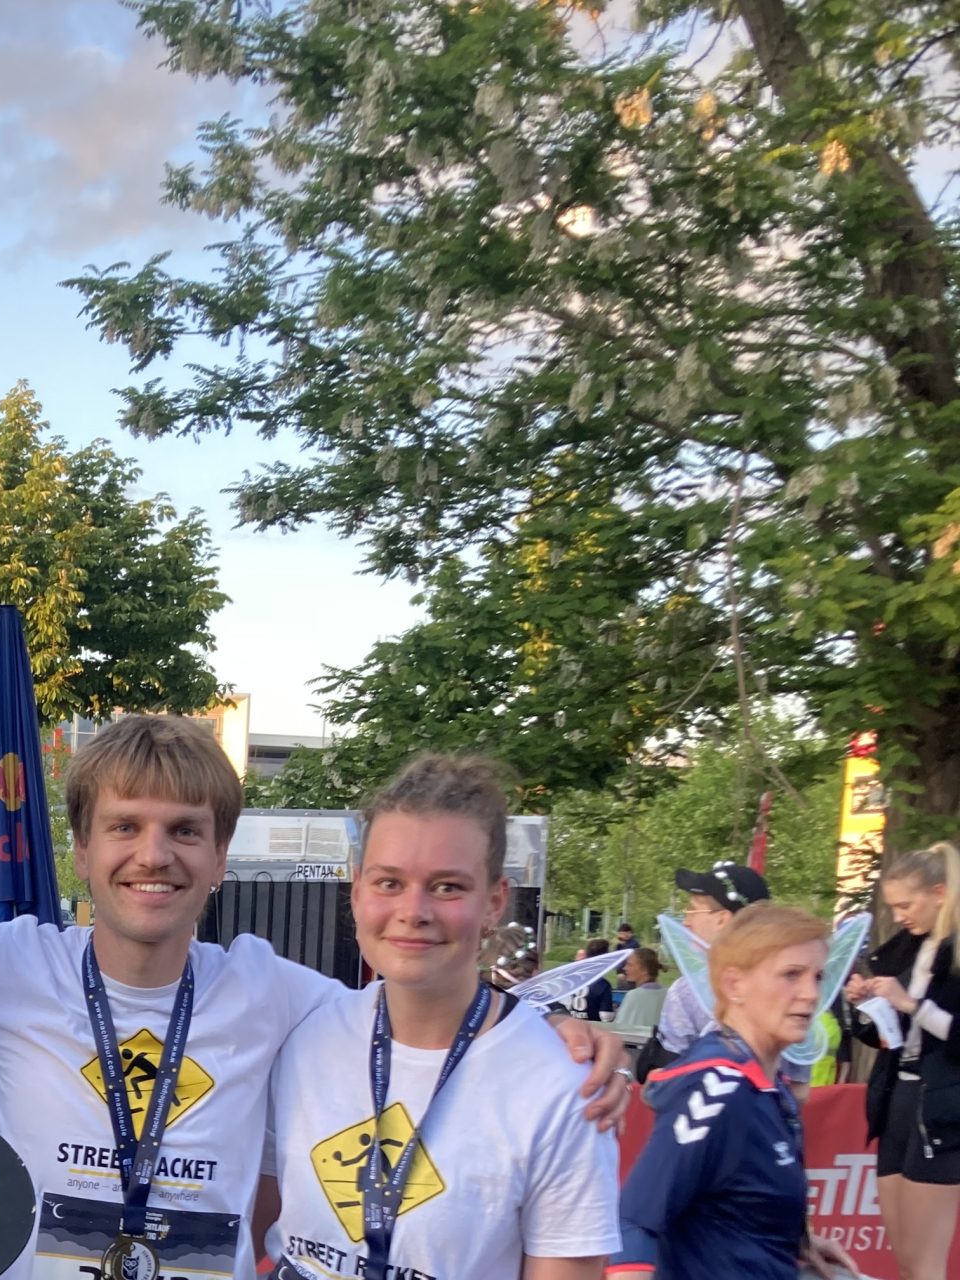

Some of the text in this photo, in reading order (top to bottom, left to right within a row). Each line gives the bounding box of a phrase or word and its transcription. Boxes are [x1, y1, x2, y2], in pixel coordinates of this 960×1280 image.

[57, 1142, 120, 1170] STREE
[155, 1157, 217, 1181] ACKET
[67, 1178, 100, 1191] anyone
[287, 1236, 347, 1271] STREET
